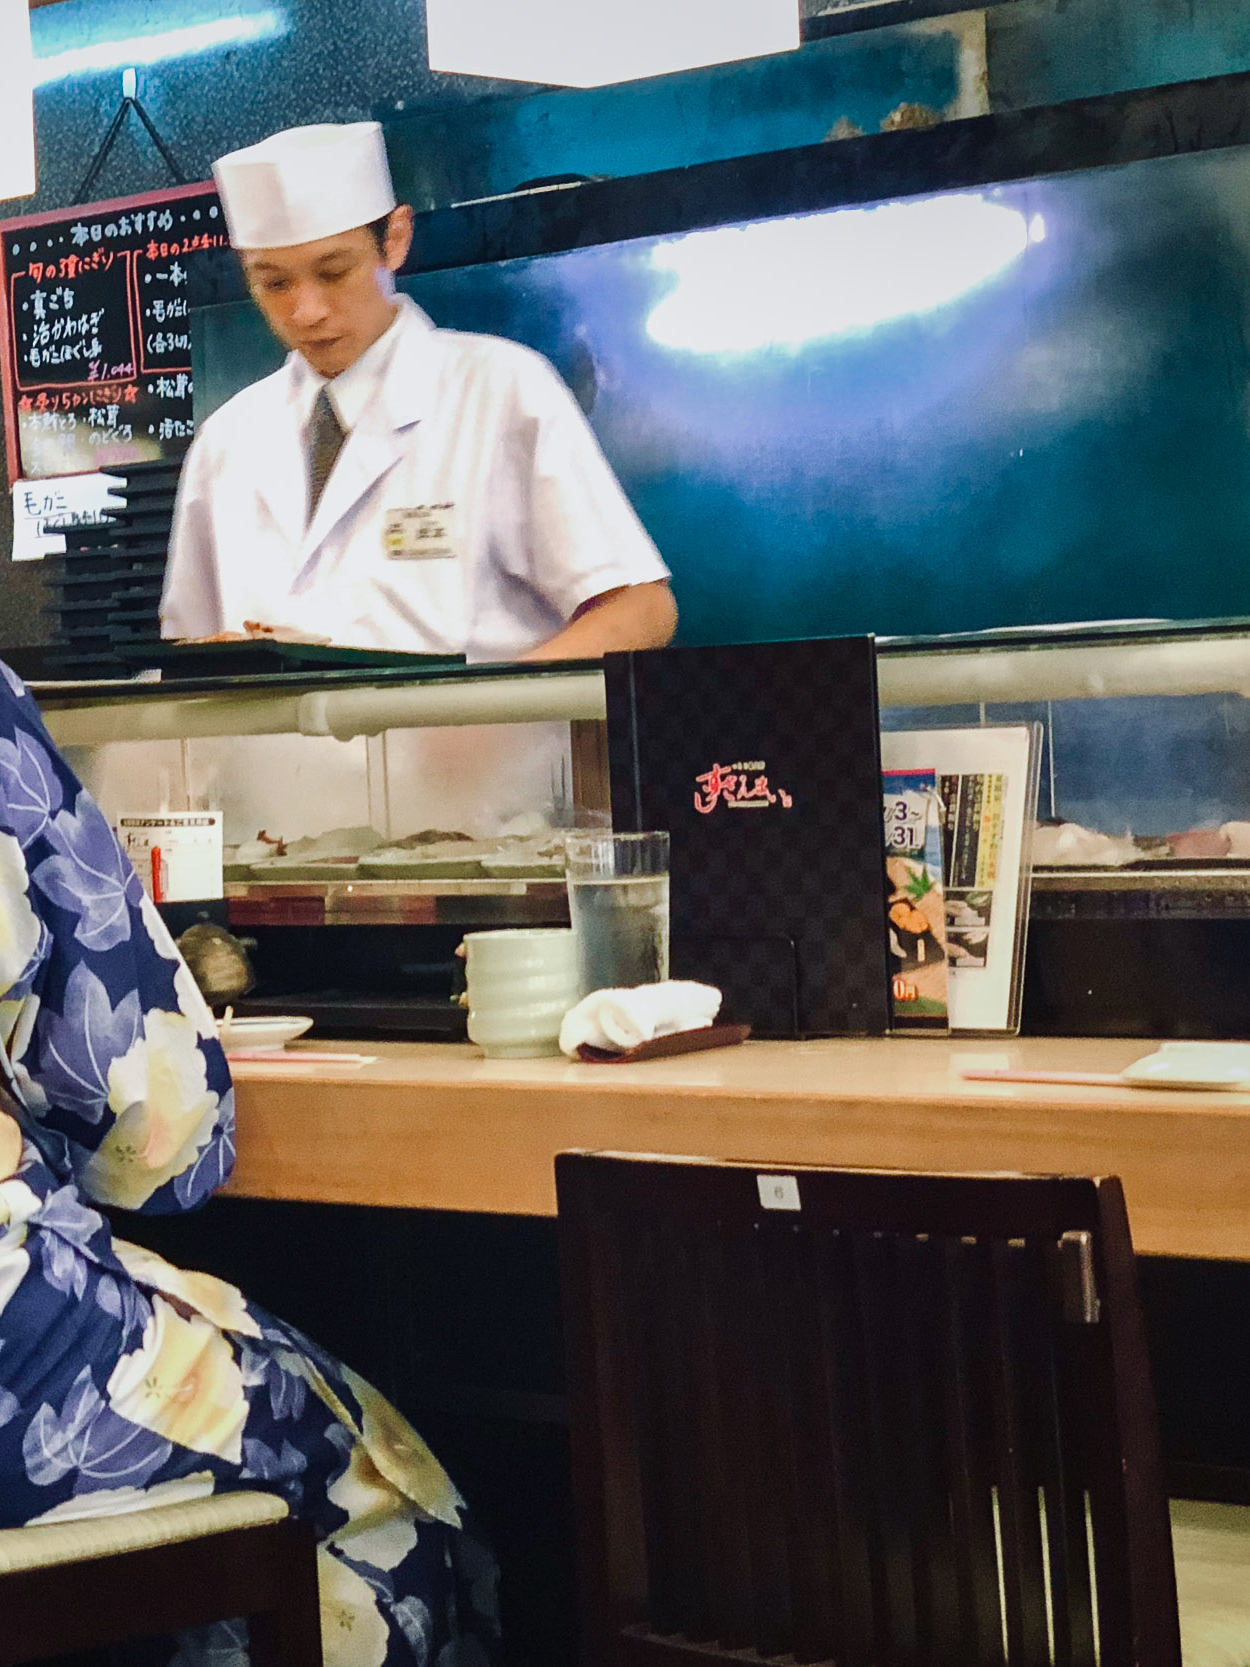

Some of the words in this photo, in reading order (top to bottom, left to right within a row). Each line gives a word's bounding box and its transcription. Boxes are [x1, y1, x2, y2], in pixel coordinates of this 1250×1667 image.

[70, 208, 174, 248] 本日のおすすめ
